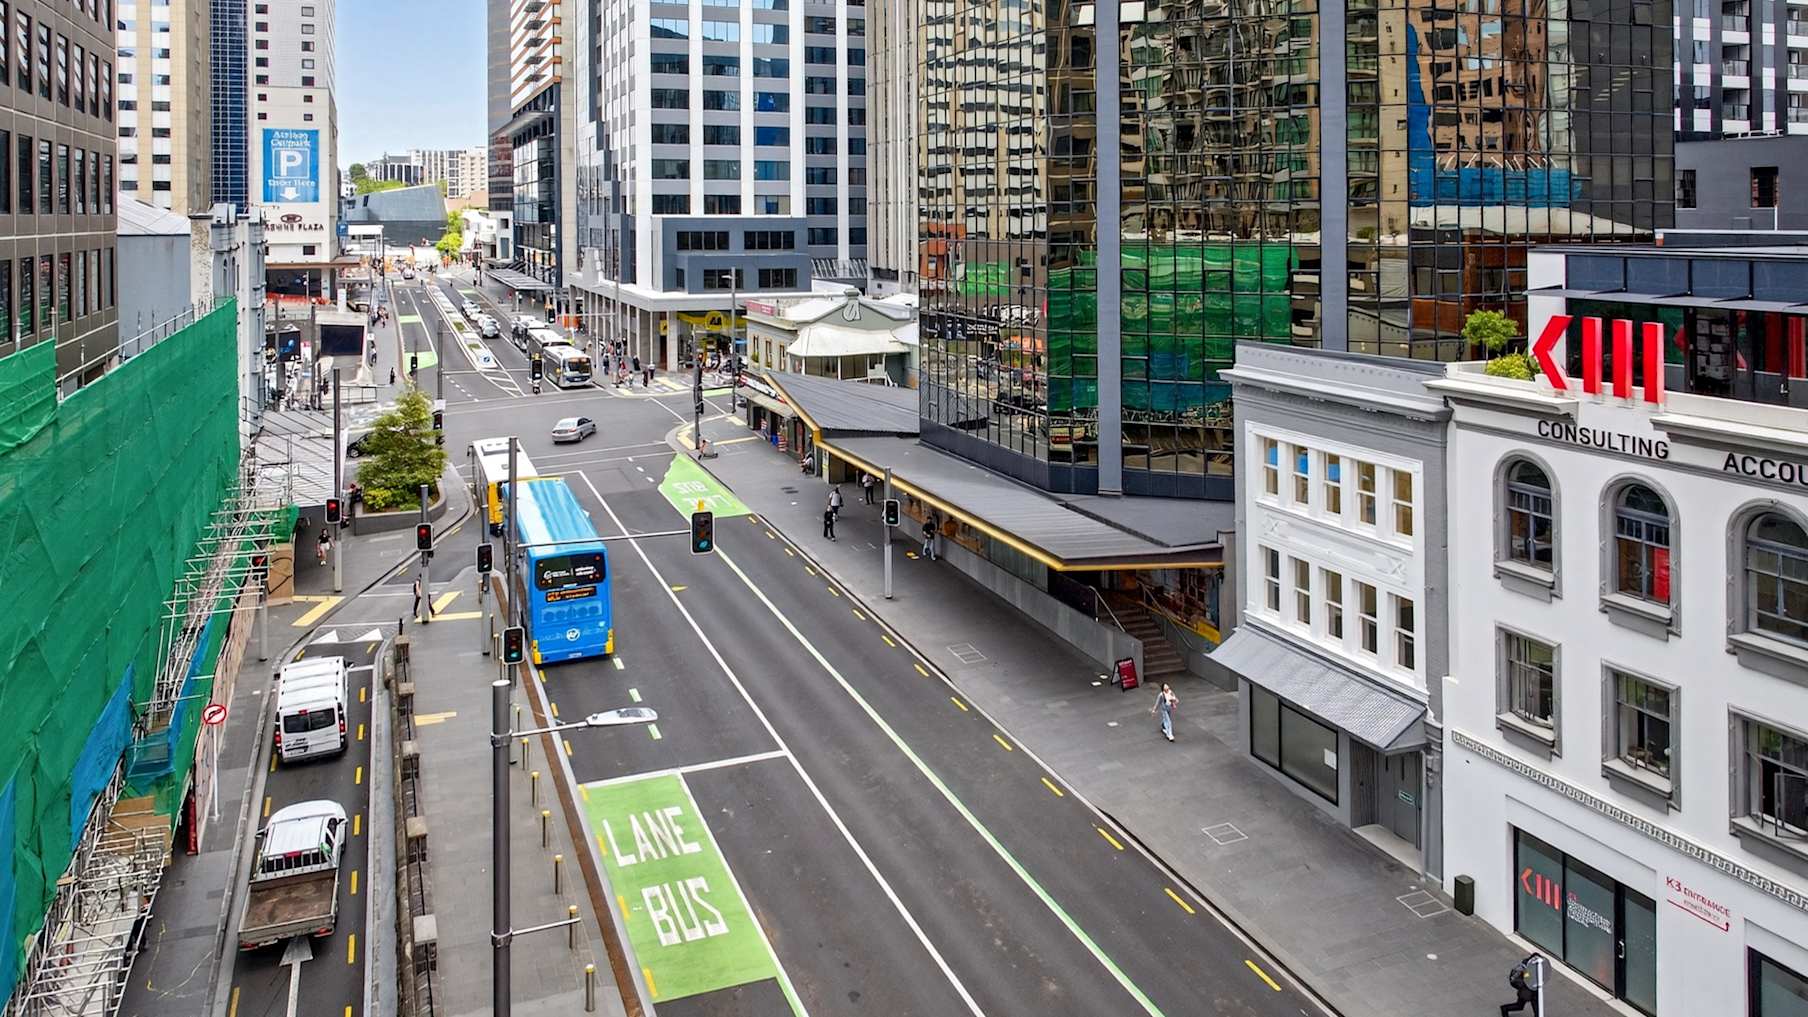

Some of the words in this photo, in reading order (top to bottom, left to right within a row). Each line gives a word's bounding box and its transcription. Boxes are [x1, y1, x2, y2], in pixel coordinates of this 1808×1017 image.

[280, 150, 302, 176] P
[298, 223, 324, 231] PLAZA
[1537, 419, 1670, 460] CONSULTING
[602, 806, 702, 867] LANE
[641, 876, 730, 947] BUS
[1666, 876, 1681, 892] K3
[1683, 887, 1730, 917] ENTRANCE
